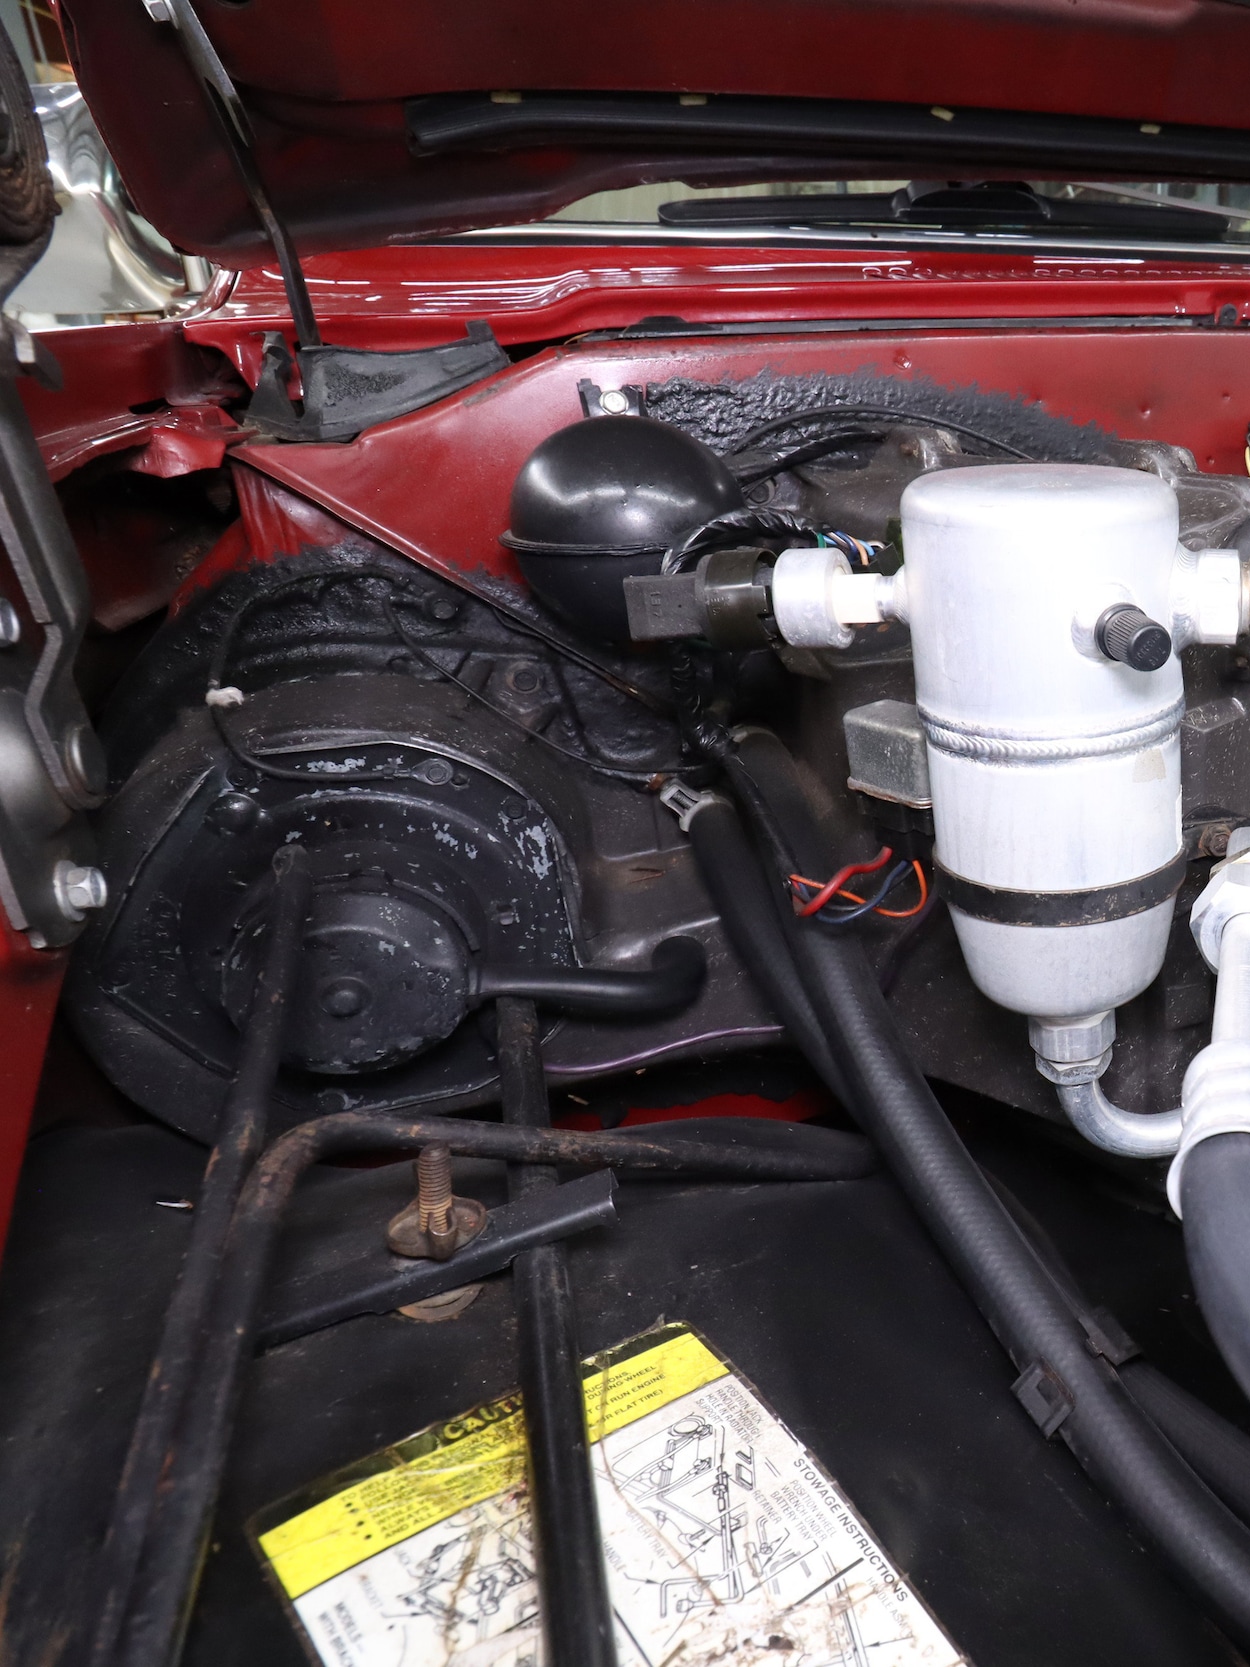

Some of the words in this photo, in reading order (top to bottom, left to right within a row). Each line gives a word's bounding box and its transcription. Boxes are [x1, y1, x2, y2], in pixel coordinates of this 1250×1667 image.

[609, 1390, 630, 1403] RUN
[630, 1372, 665, 1393] ENGINE
[624, 1363, 656, 1383] WHEEL
[614, 1400, 638, 1415] FLAT
[637, 1388, 663, 1404] TIRE)
[695, 1397, 723, 1425] SUPPORT
[715, 1388, 738, 1411] HANDLE
[733, 1409, 762, 1438] THROUGH
[723, 1384, 750, 1409] POSITION
[443, 1392, 525, 1439] CAUTI
[705, 1393, 722, 1408] HOLE
[718, 1407, 728, 1415] IN
[724, 1413, 753, 1443] RADIATOR
[750, 1489, 782, 1524] RETAINER
[769, 1490, 798, 1522] BATTERY
[793, 1520, 813, 1542] TRAY
[779, 1484, 809, 1517] WRENCH
[804, 1514, 828, 1542] UNDER
[788, 1479, 819, 1513] POSITION
[814, 1511, 838, 1538] WHEEL
[792, 1457, 842, 1514] STOWAGE
[835, 1511, 909, 1603] INSTRUCTIONS
[600, 1540, 627, 1573] HANDLE
[648, 1538, 669, 1559] TRAY
